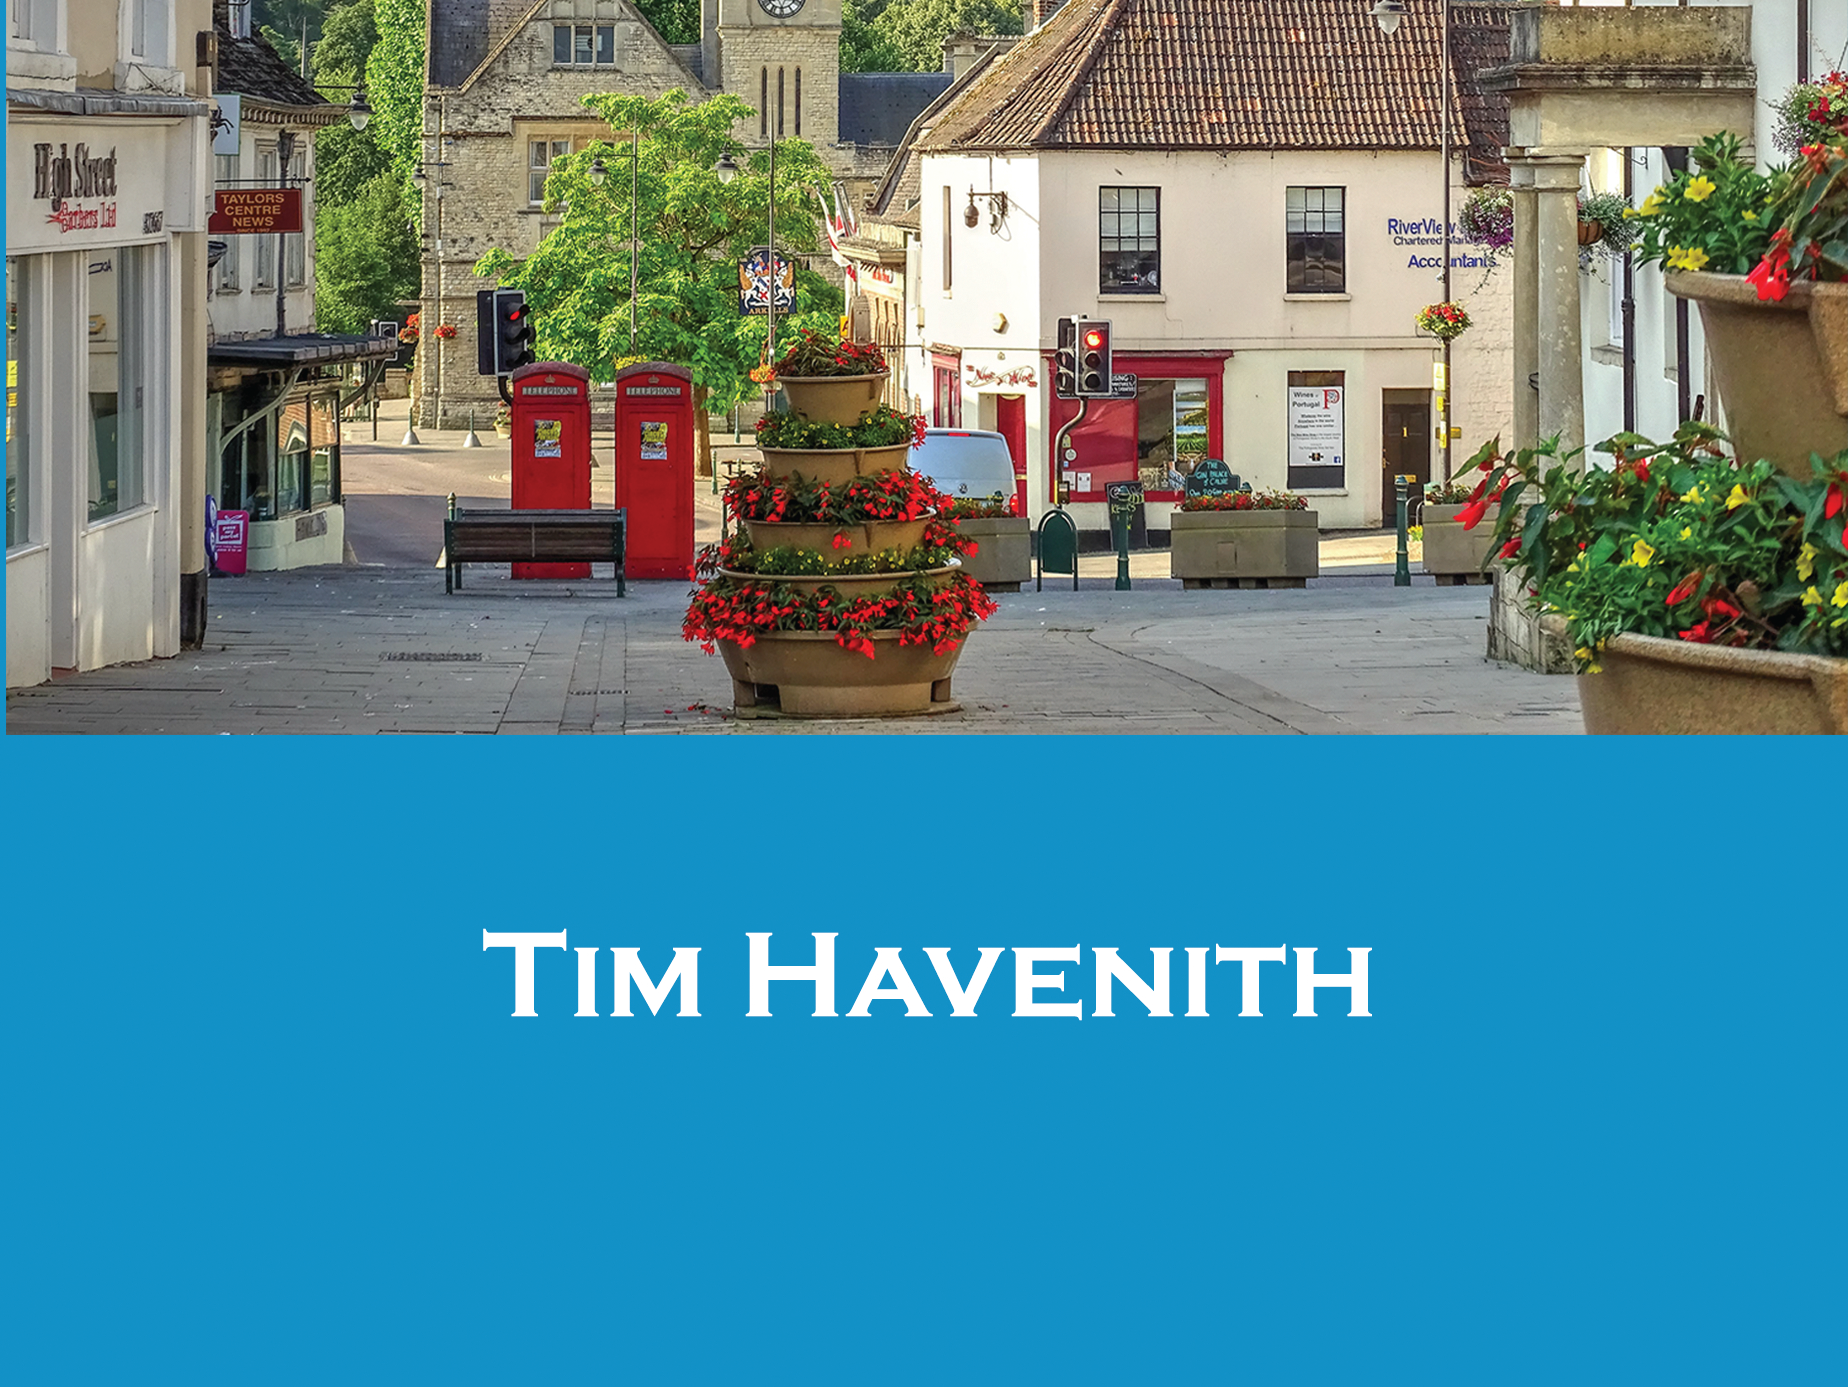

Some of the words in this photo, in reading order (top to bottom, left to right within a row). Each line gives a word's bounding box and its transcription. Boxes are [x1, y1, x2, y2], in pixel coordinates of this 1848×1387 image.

[33, 142, 72, 212] High
[74, 142, 117, 198] Street
[221, 193, 285, 204] TAYLORS
[224, 205, 281, 216] CENTRE
[232, 216, 274, 227] NEWS
[1393, 235, 1442, 246] Chartered
[523, 387, 578, 395] TELEPHONE
[627, 387, 681, 395] TELEPHONE
